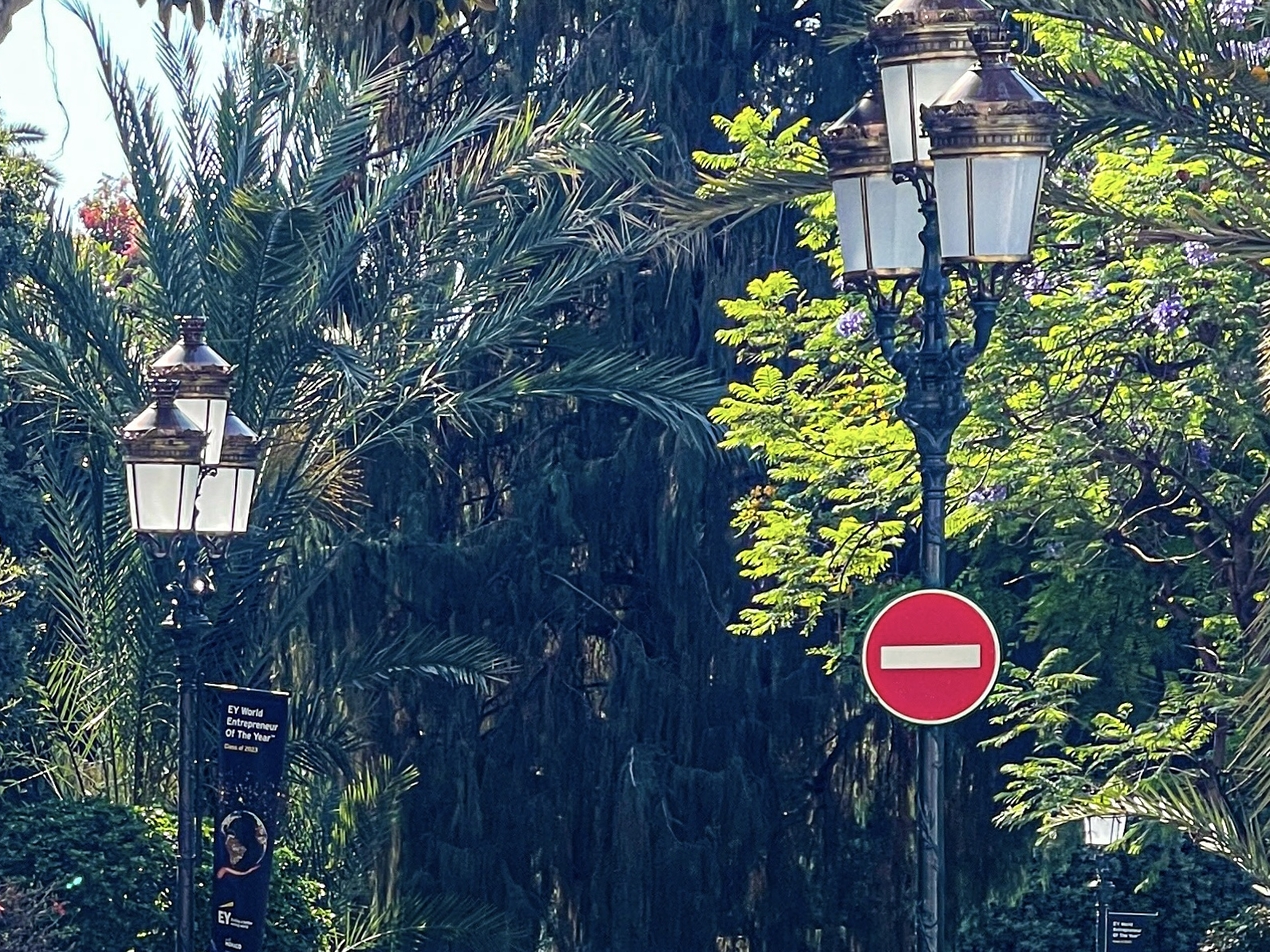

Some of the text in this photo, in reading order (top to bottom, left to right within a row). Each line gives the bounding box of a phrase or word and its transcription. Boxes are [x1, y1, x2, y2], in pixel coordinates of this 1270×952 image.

[228, 705, 263, 717] EY World
[227, 717, 278, 731] Entrepreneur
[225, 729, 235, 737] Of
[237, 730, 251, 740] The
[218, 910, 231, 925] EY
